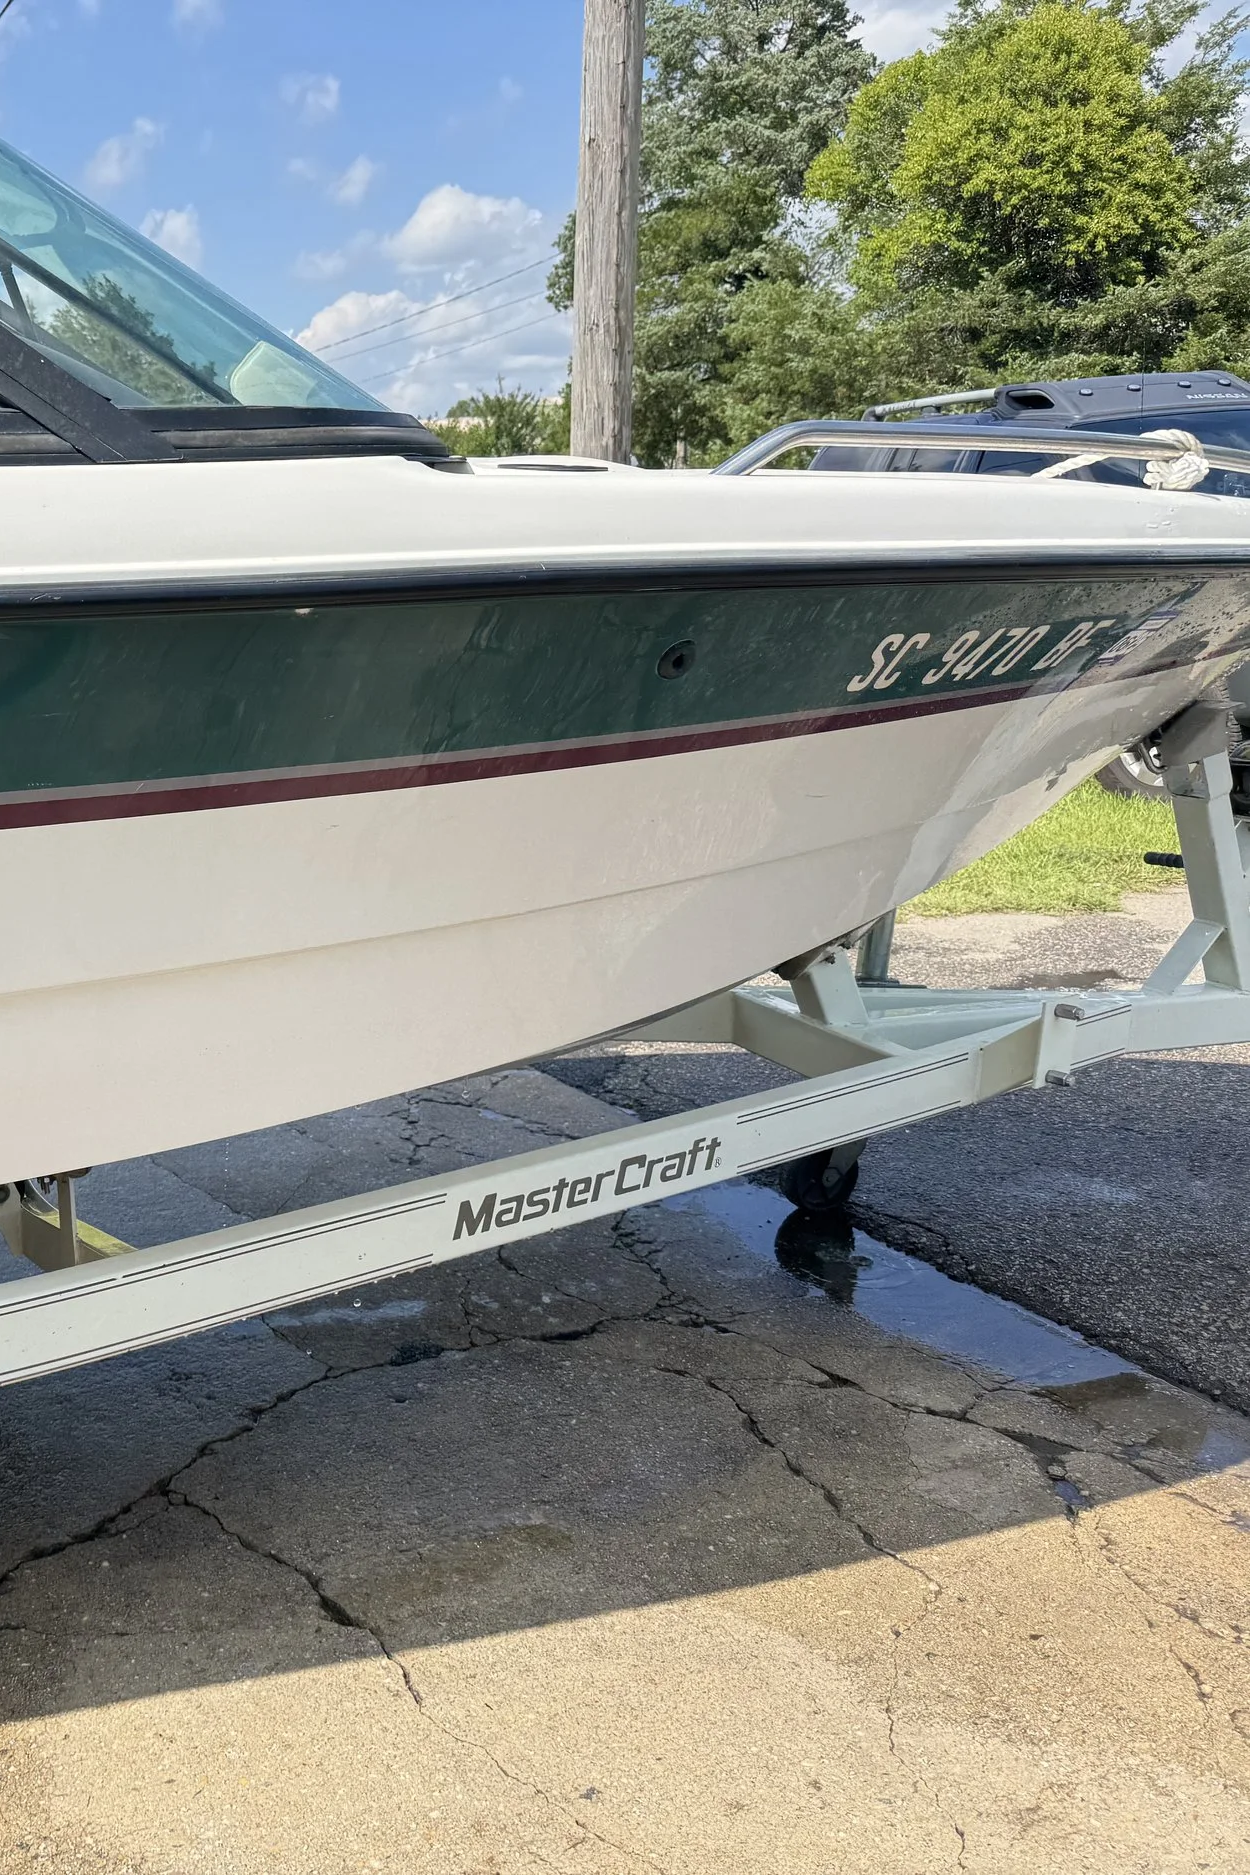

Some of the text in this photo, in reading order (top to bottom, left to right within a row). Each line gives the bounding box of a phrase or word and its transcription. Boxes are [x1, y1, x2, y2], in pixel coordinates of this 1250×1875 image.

[1185, 392, 1248, 400] NISSAN
[847, 632, 931, 693] SC
[921, 624, 1050, 685] 9470
